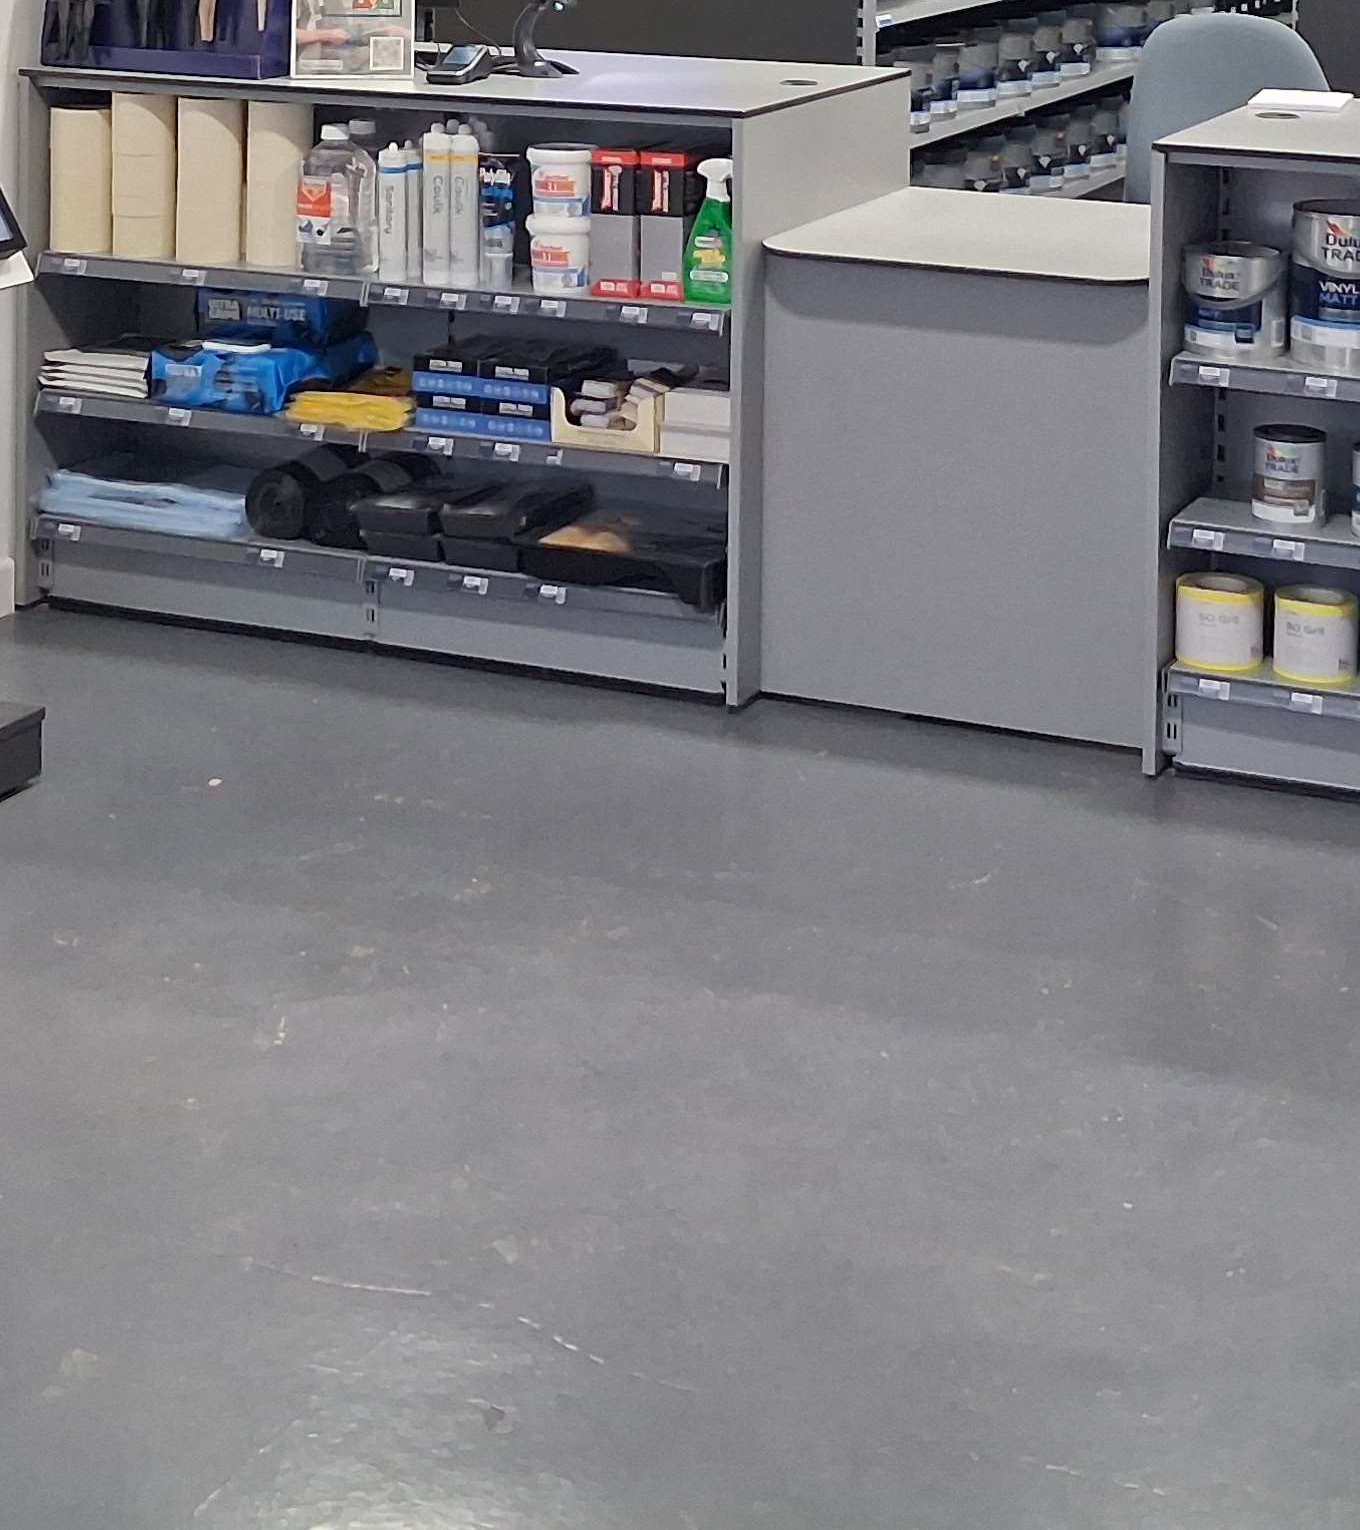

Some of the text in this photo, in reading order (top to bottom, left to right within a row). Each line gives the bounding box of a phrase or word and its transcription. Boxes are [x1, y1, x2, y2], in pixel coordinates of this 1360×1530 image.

[1318, 280, 1360, 295] VINYL
[1318, 292, 1360, 306] MATT
[246, 303, 307, 323] MULTI-USE
